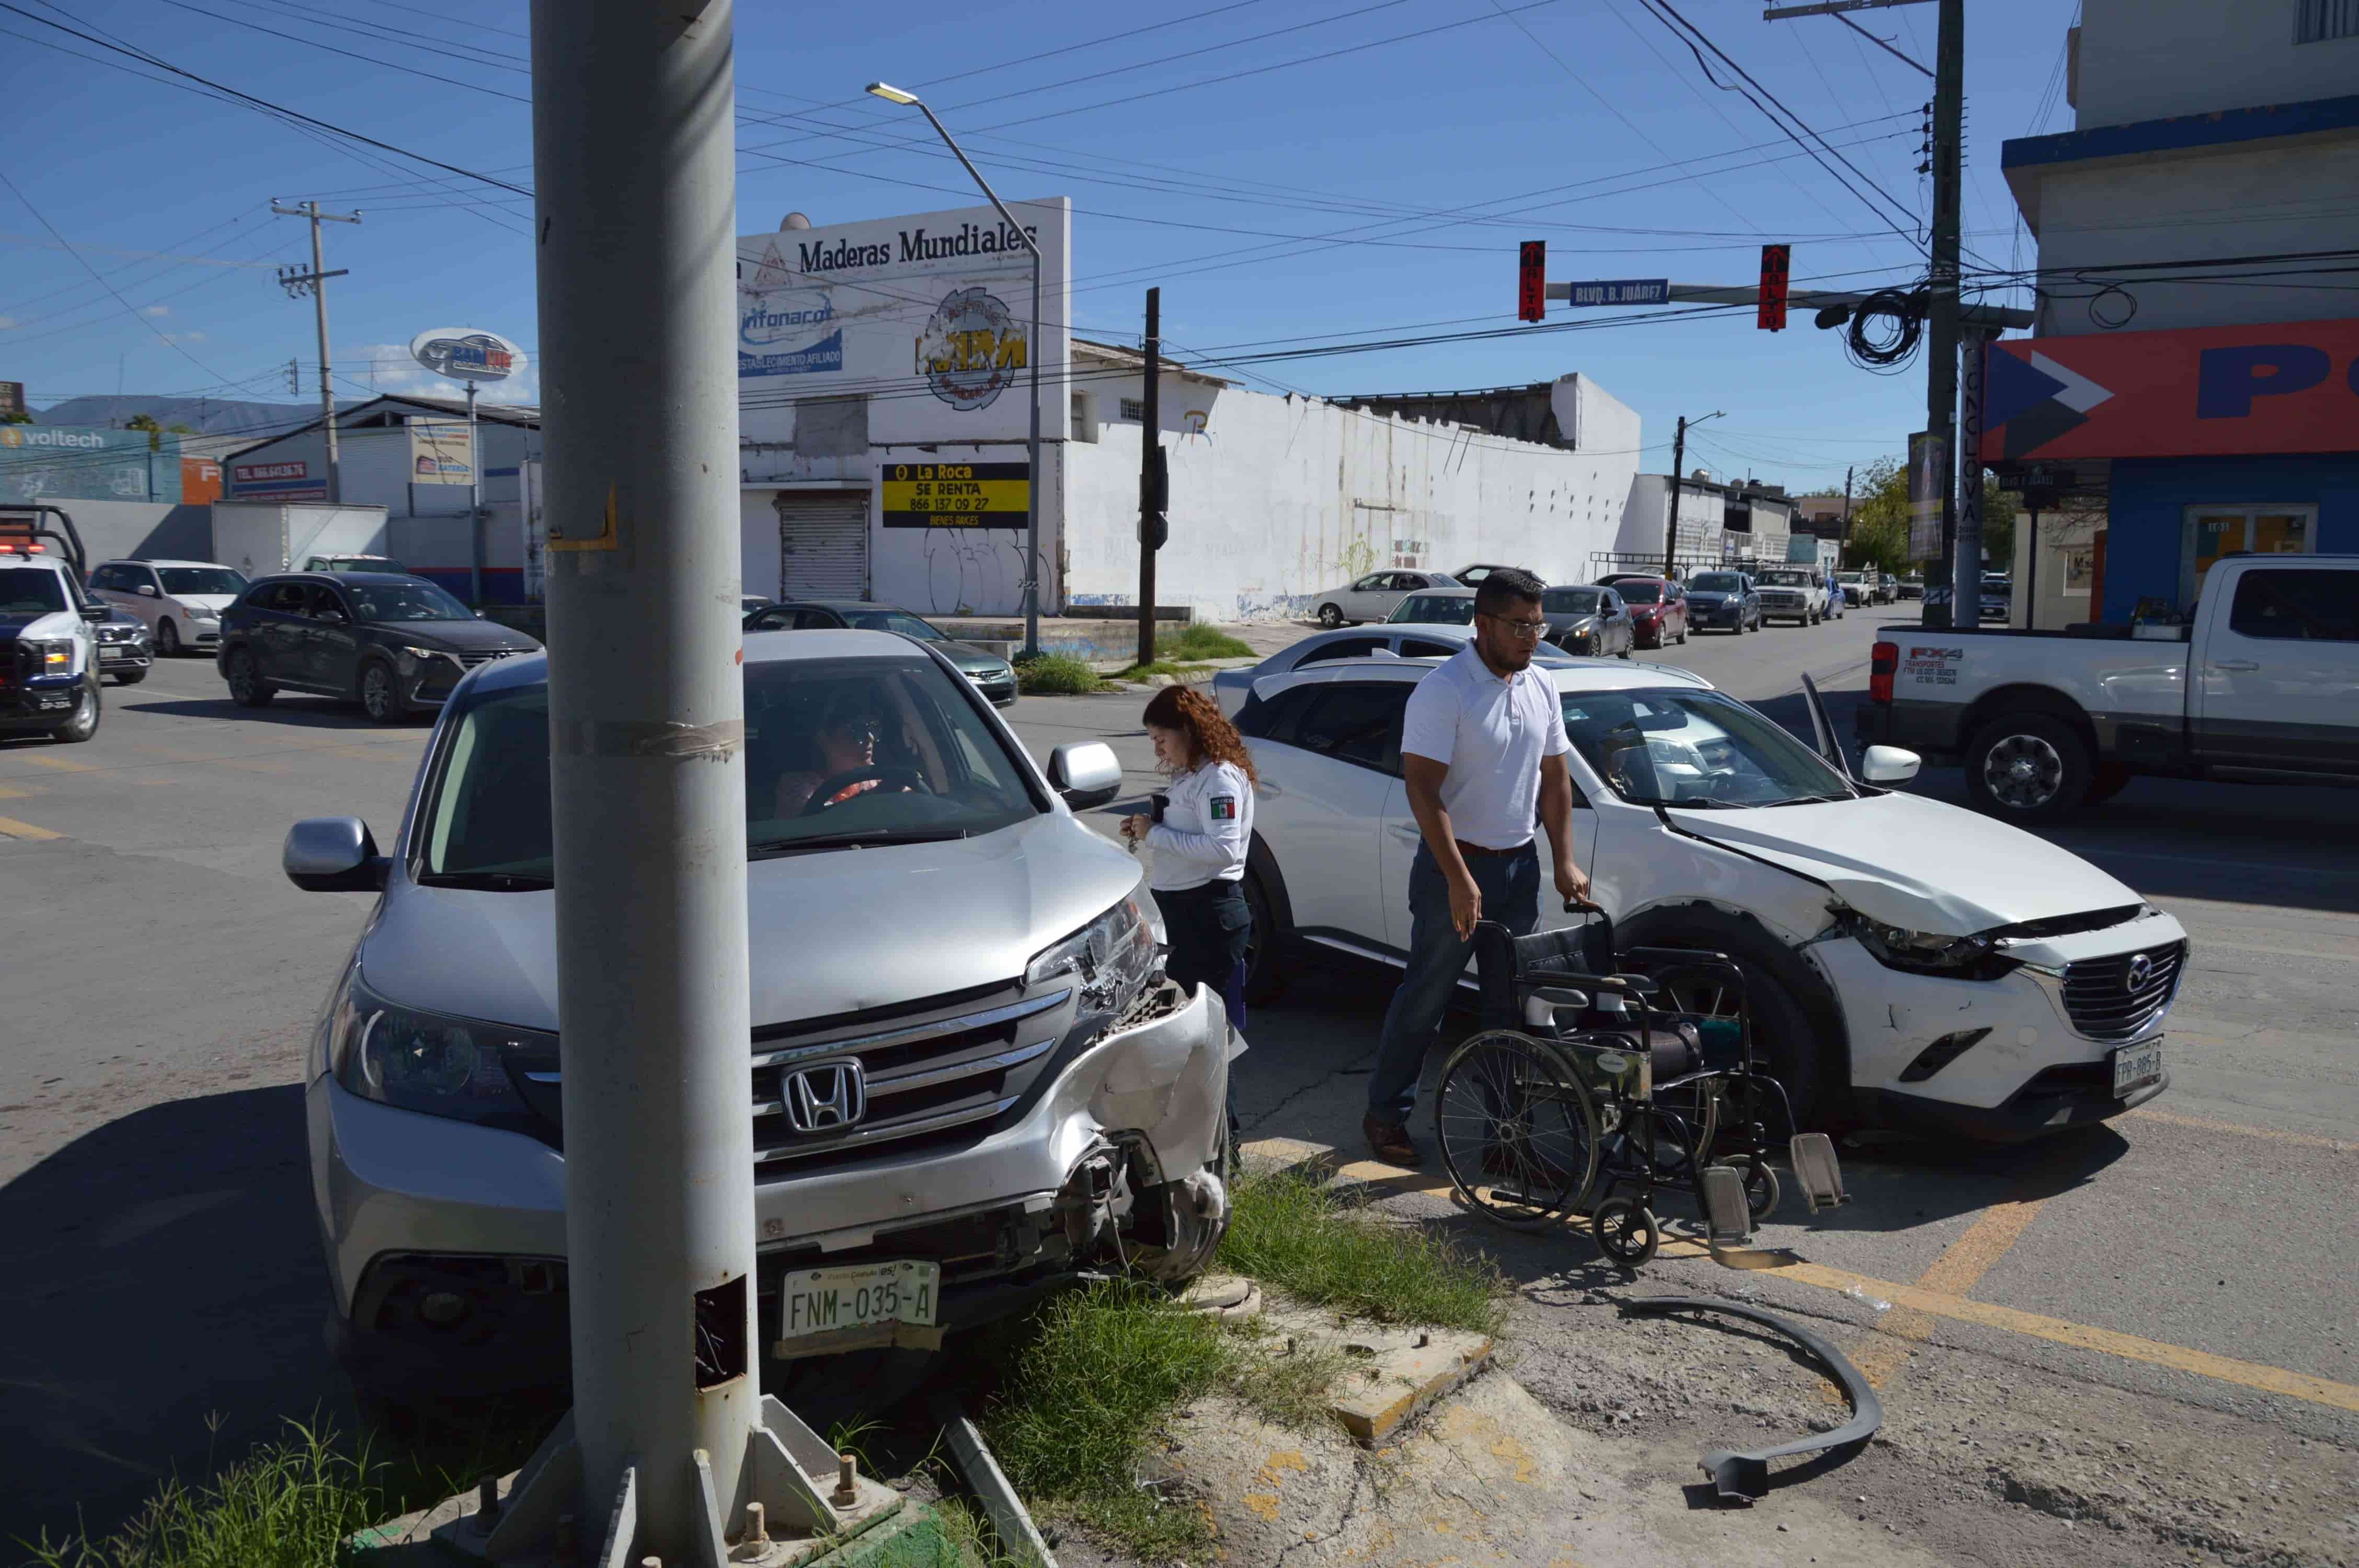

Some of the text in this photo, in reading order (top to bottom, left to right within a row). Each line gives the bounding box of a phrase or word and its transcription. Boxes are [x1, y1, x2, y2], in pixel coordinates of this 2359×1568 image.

[798, 222, 1038, 273] Maderas Mundiales
[1608, 286, 1619, 302] B.
[26, 429, 105, 448] voltech
[917, 465, 933, 479] La
[938, 464, 972, 479] Roca
[916, 483, 981, 495] SE RENTA
[910, 498, 989, 510] 866 137 09 27
[1910, 647, 1963, 660] FX4
[1905, 659, 1945, 668] TRANSPORTES
[791, 1279, 929, 1330] FNM-035-A
